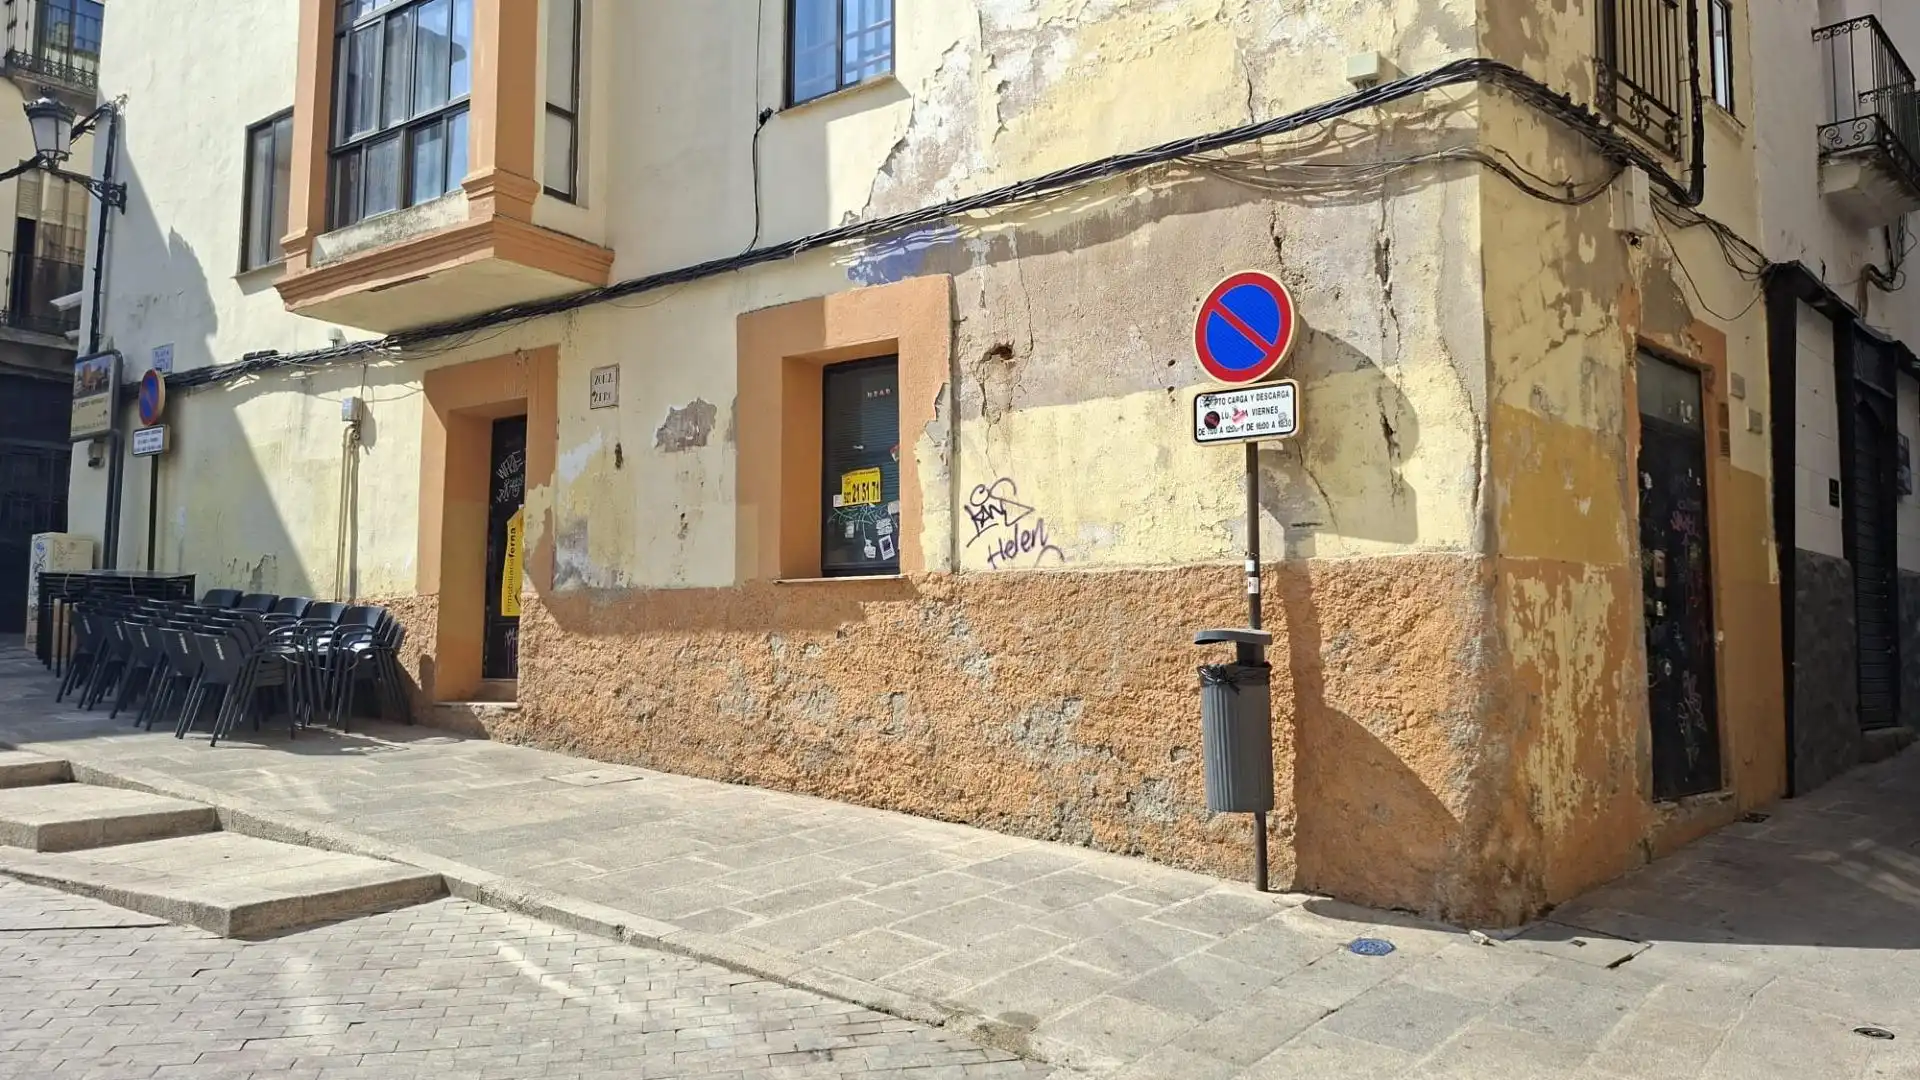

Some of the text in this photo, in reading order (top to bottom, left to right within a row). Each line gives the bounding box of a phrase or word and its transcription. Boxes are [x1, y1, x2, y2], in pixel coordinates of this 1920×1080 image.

[1228, 395, 1248, 405] CARGA
[1256, 390, 1290, 402] DESCARGA
[1252, 405, 1279, 417] VIERNES
[1198, 428, 1206, 436] DE
[1246, 422, 1254, 431] DE
[987, 517, 1049, 569] Helen
